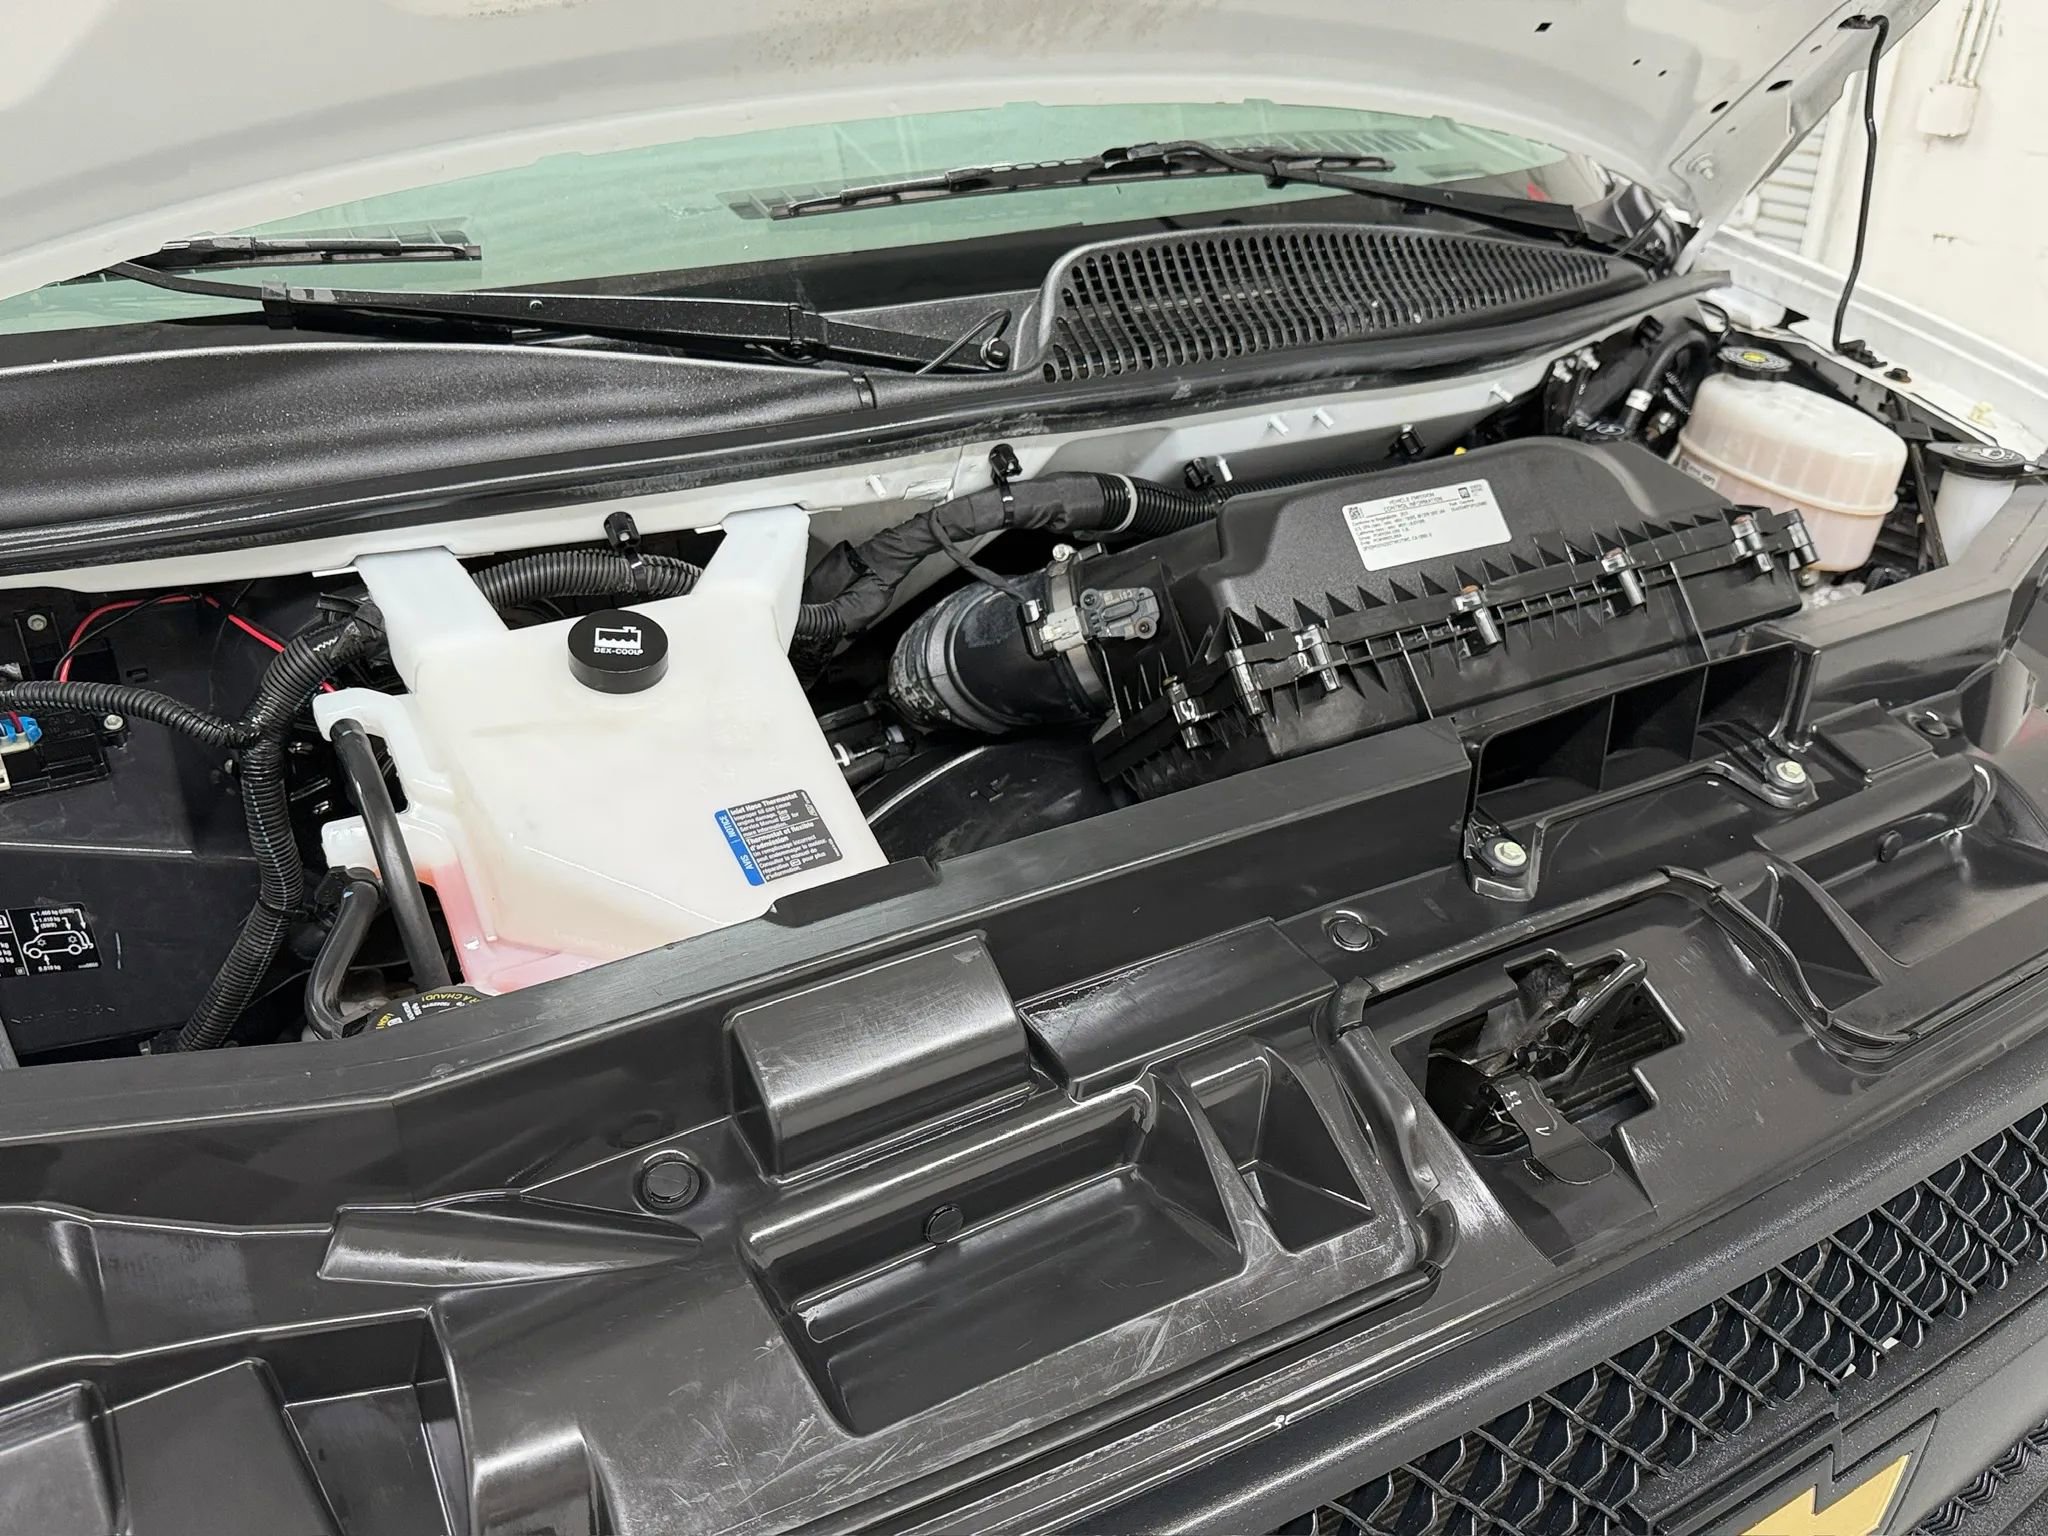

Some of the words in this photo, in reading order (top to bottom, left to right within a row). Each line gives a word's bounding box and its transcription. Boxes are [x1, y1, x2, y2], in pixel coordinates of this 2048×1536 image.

[1383, 503, 1407, 511] CONTROL
[745, 802, 762, 810] Hose
[761, 793, 798, 806] Thermostat
[718, 814, 736, 837] NOTICE
[739, 822, 760, 832] Service
[746, 830, 783, 844] Thermostat
[739, 854, 754, 870] AVIS
[422, 993, 463, 1001] CHAUD!
